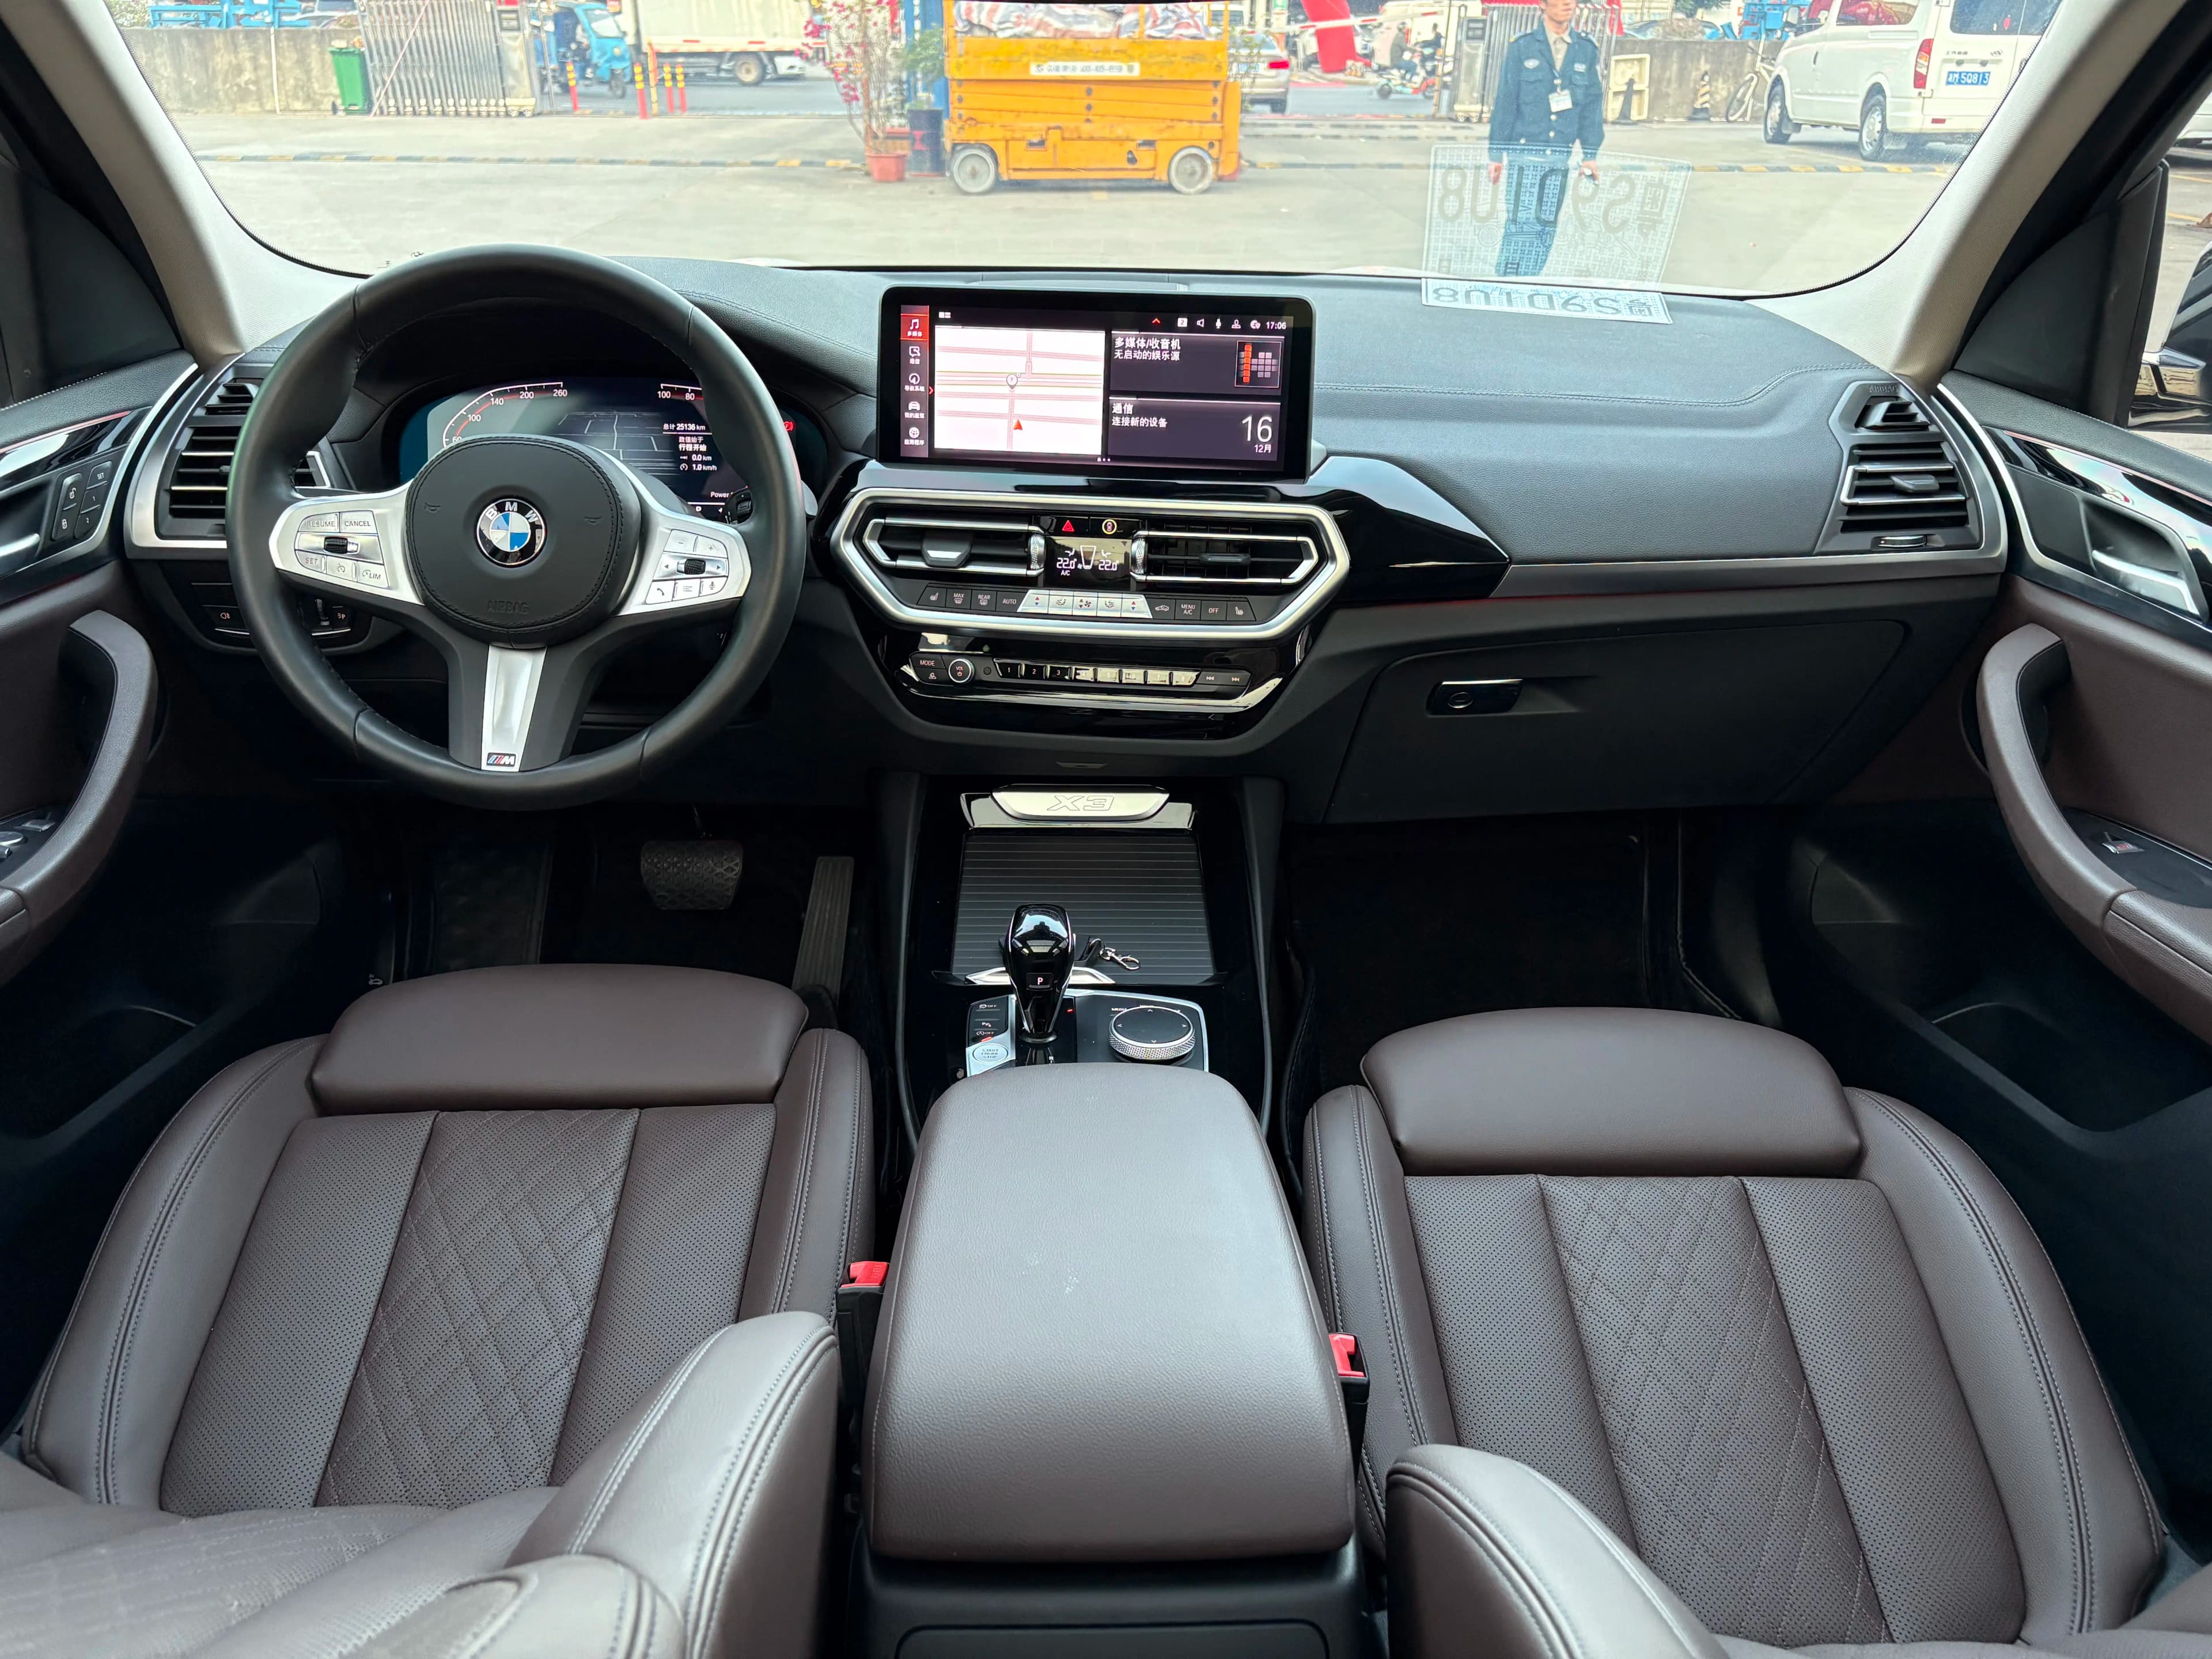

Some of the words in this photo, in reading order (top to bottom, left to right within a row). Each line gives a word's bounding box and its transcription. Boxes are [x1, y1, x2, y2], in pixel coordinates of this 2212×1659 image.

[1266, 321, 1286, 329] 17:06
[1115, 337, 1180, 350] 多媒体/收音机
[1114, 350, 1180, 361] 无启动的娱乐源
[1869, 385, 1899, 393] AIRBAG
[657, 391, 671, 399] 100
[491, 397, 503, 406] 140
[1112, 403, 1134, 415] 通信
[1112, 416, 1168, 428] 连接新的设备
[1242, 415, 1272, 442] 16
[679, 444, 707, 452] 行程开始
[1255, 444, 1271, 454] 12月
[485, 502, 539, 523] BMW
[487, 600, 529, 614] AIRBAG
[1046, 795, 1115, 811] X3
[1037, 977, 1043, 986] P
